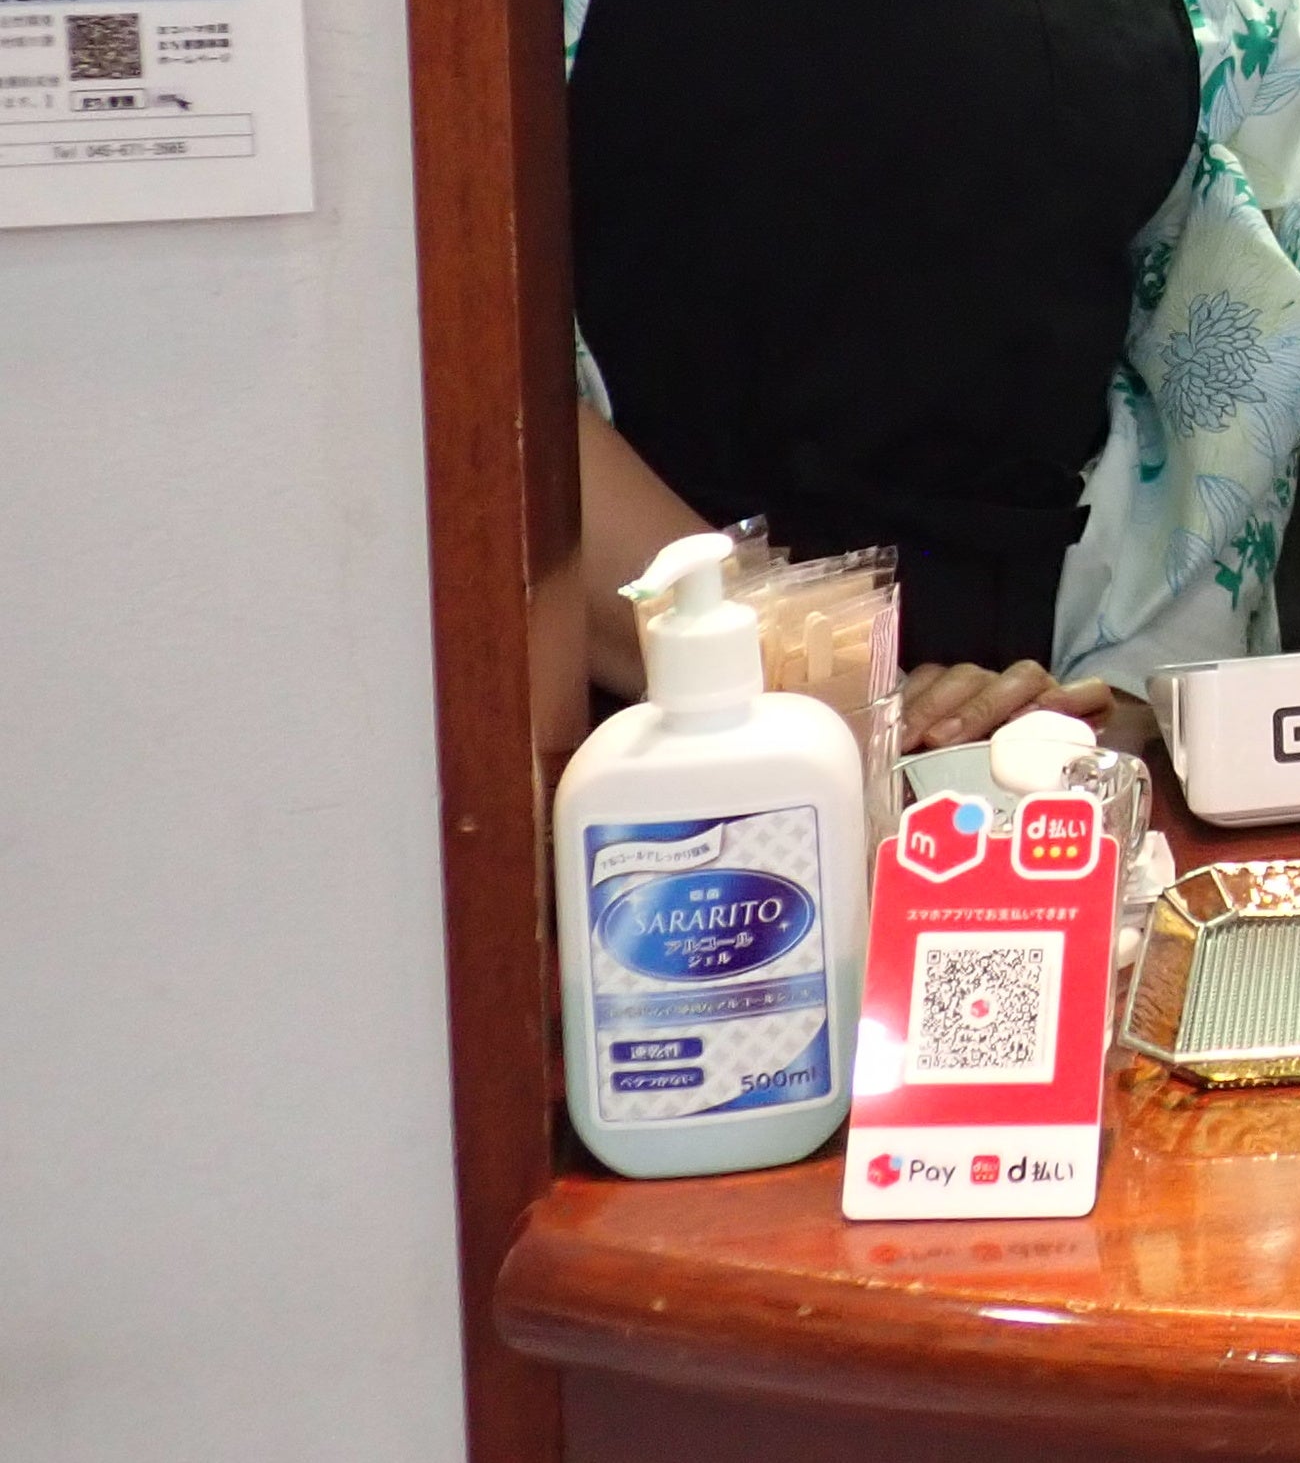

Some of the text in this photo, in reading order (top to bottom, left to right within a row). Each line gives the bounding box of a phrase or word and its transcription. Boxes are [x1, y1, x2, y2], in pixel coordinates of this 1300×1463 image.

[1027, 815, 1087, 839] d払い
[631, 898, 783, 936] SARARITO
[663, 931, 754, 956] アルコール
[740, 1065, 816, 1092] 500ml
[908, 1159, 957, 1187] Pay
[1007, 1156, 1075, 1184] d払い
